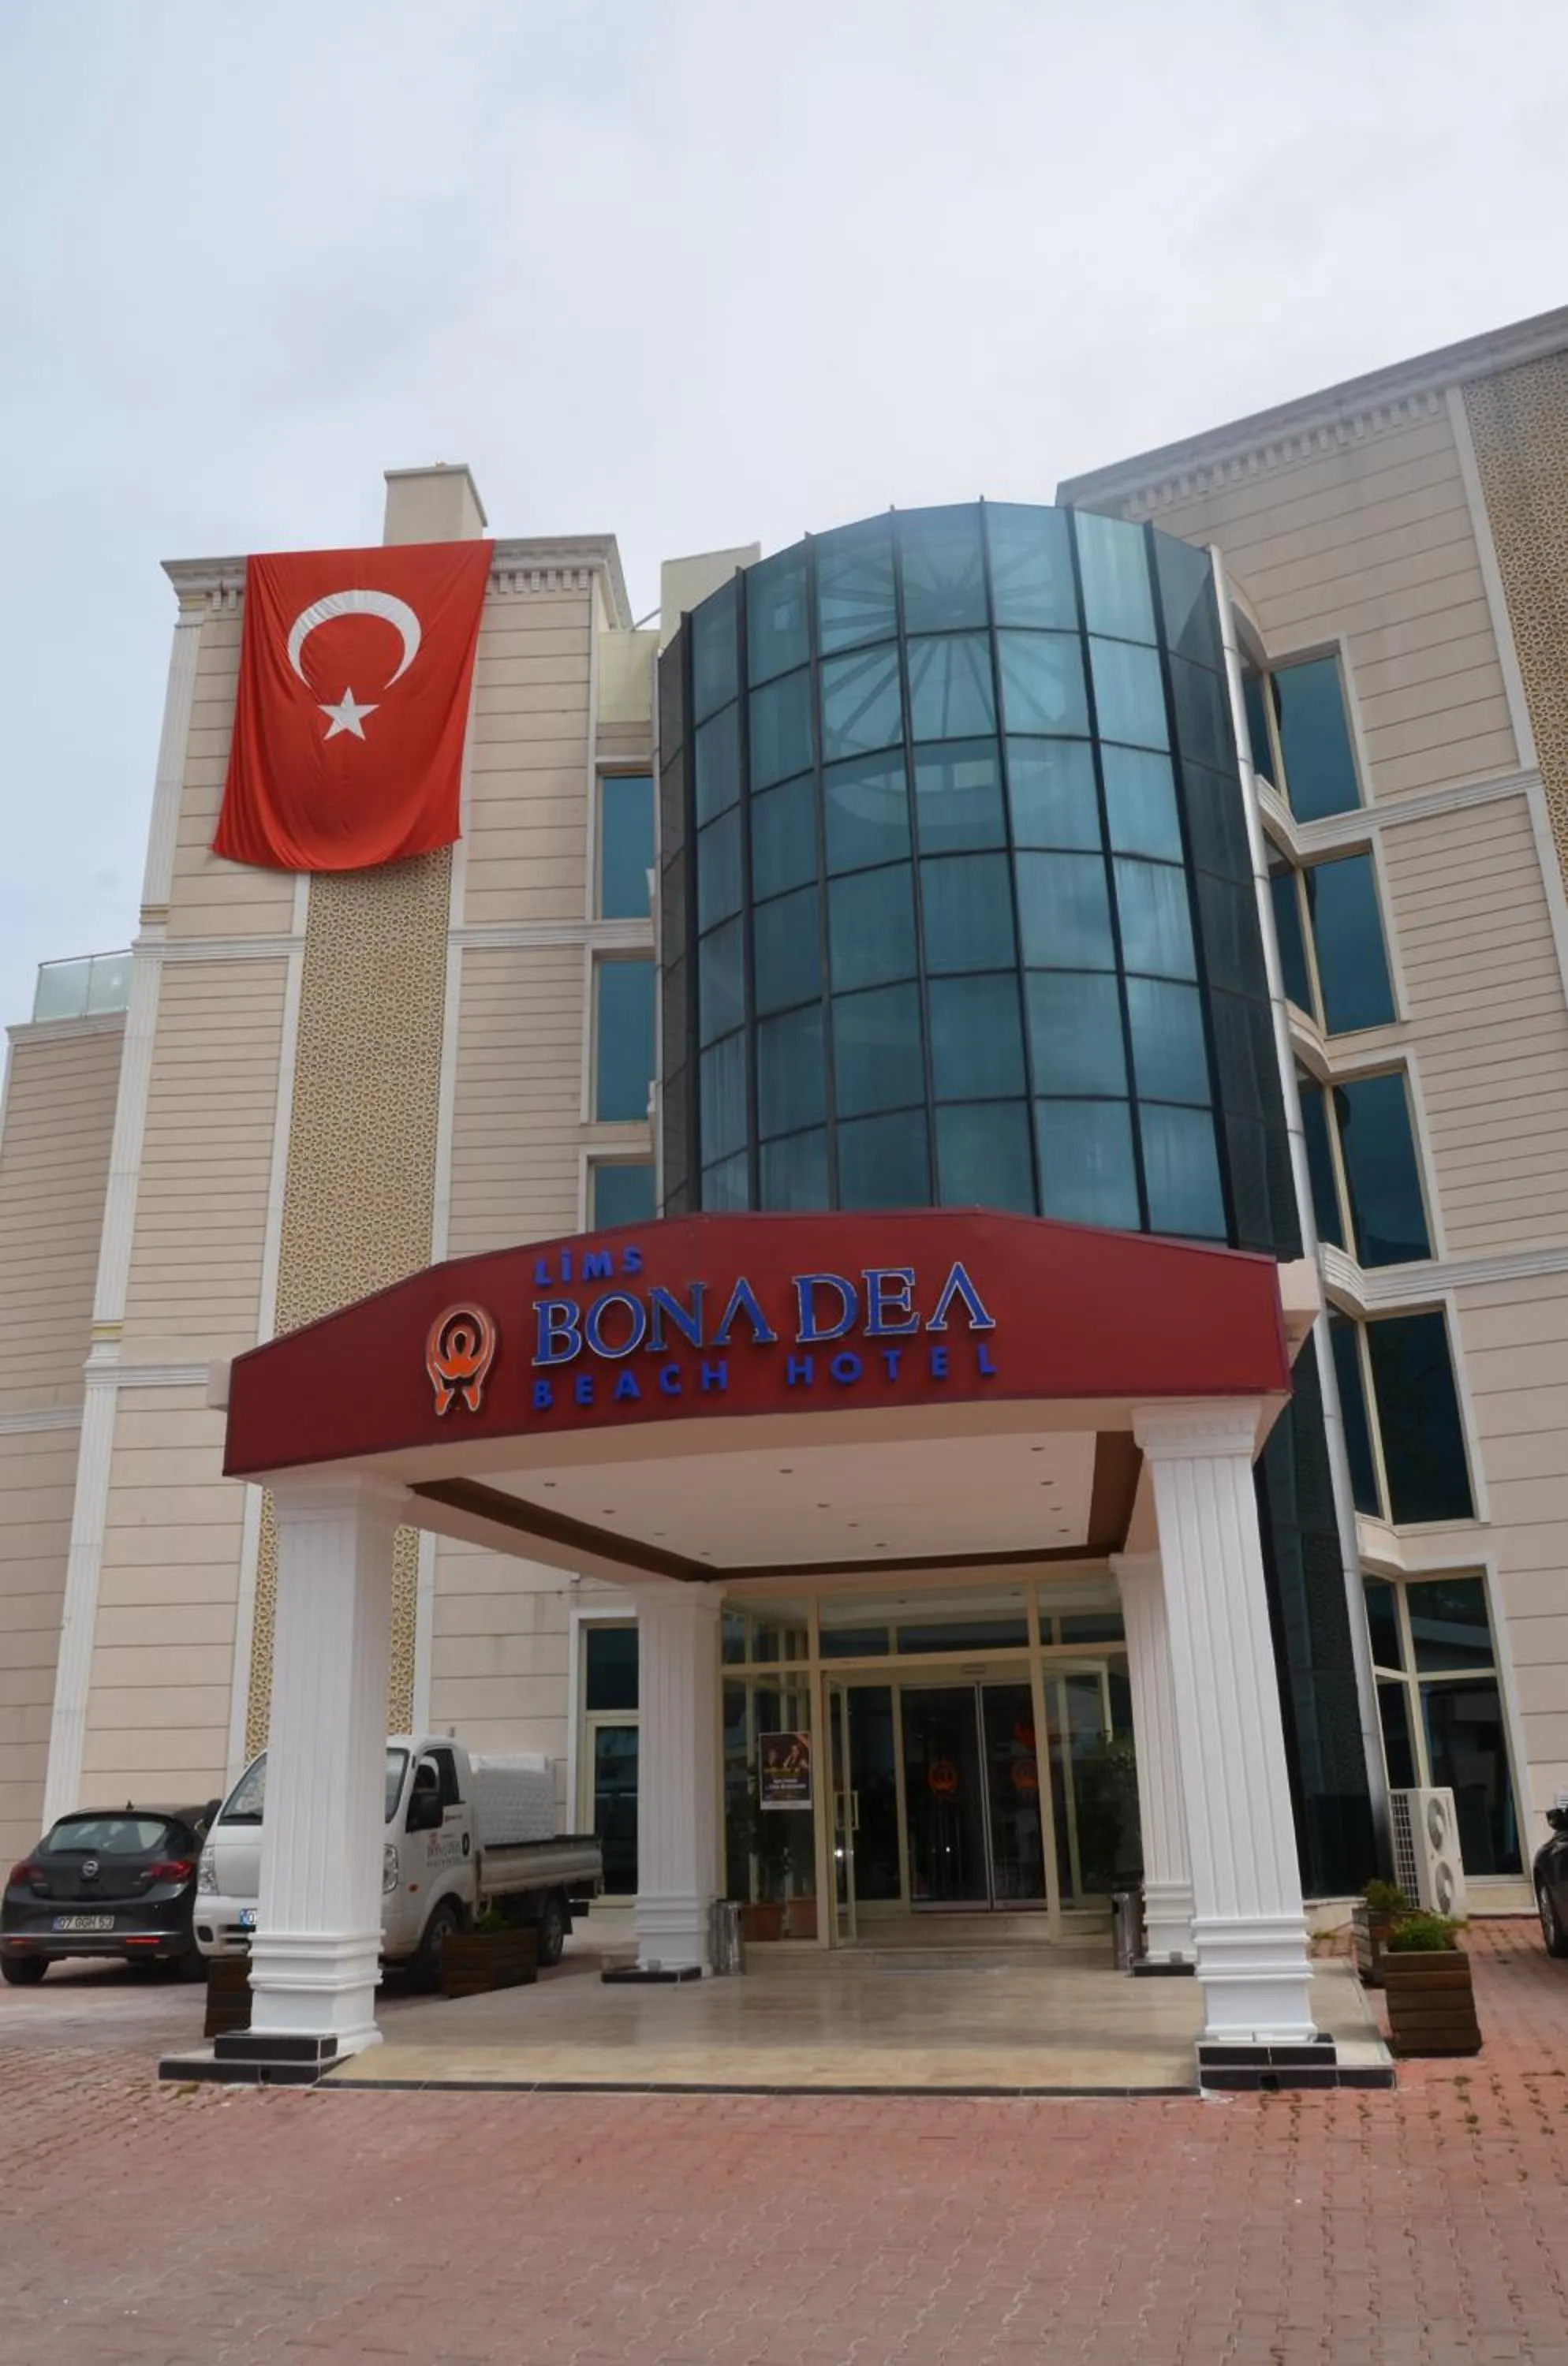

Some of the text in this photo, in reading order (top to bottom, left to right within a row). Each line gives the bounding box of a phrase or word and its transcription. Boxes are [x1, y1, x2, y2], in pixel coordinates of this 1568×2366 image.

[531, 1261, 997, 1367] BONA DEA
[532, 1342, 999, 1410] BEACH HOTEL
